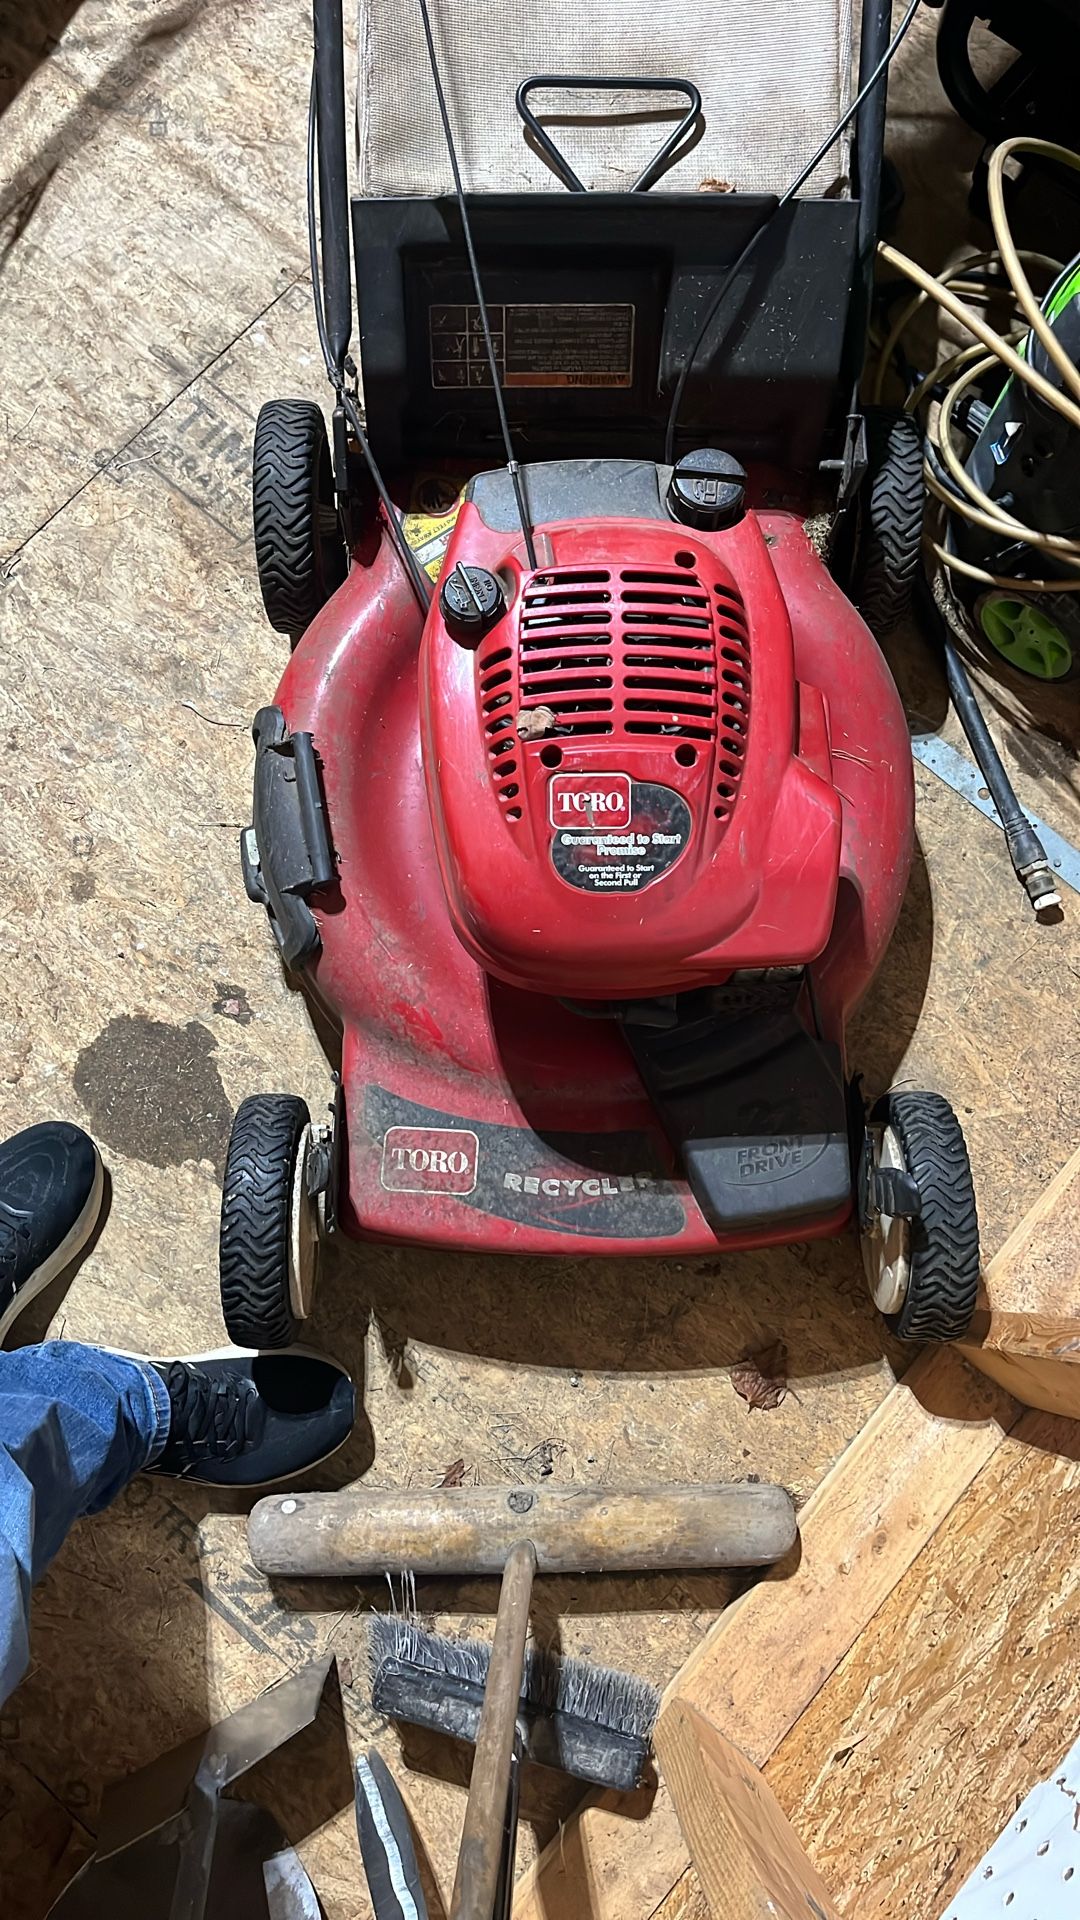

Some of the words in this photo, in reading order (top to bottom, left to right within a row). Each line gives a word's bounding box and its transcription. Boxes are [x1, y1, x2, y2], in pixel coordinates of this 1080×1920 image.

[566, 375, 617, 385] WARNING
[560, 833, 635, 845] Guaranteed
[637, 834, 650, 845] to
[651, 833, 682, 845] Start
[596, 844, 647, 856] Promise
[578, 864, 625, 872] Guaranteed
[626, 864, 634, 872] to
[635, 864, 655, 872] Start
[589, 872, 601, 880] on
[601, 871, 614, 880] the
[615, 871, 632, 880] First
[633, 872, 642, 880] or
[594, 879, 623, 887] Second
[624, 879, 639, 887] Pull
[738, 1136, 803, 1165] FRONT
[391, 1148, 470, 1175] TORO
[740, 1150, 802, 1178] DRIVE
